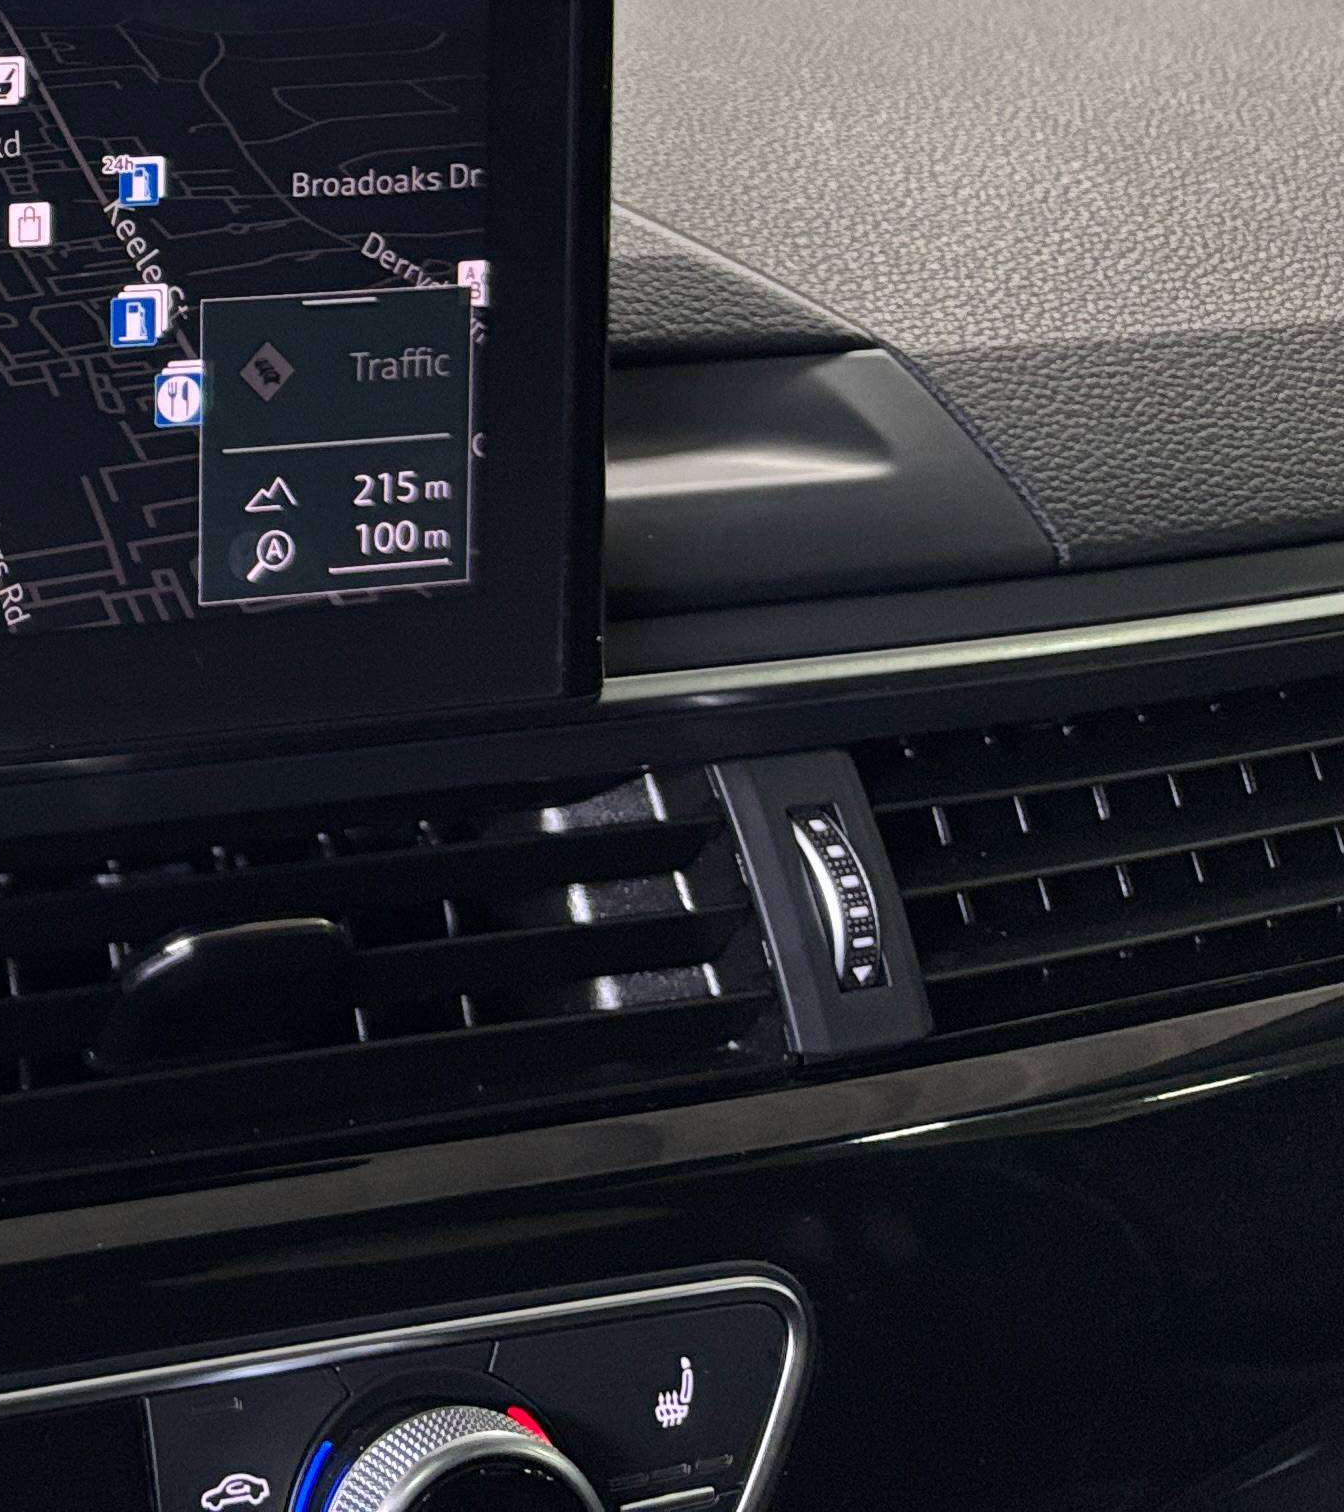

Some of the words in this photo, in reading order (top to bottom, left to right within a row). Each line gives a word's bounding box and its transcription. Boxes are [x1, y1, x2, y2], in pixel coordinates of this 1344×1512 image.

[291, 166, 442, 198] Broadoaks
[449, 163, 483, 188] Dr
[103, 197, 162, 285] Keele
[350, 346, 451, 382] Traffic
[353, 471, 419, 507] 215
[424, 480, 452, 500] m
[355, 520, 419, 556] 100
[424, 529, 451, 550] m
